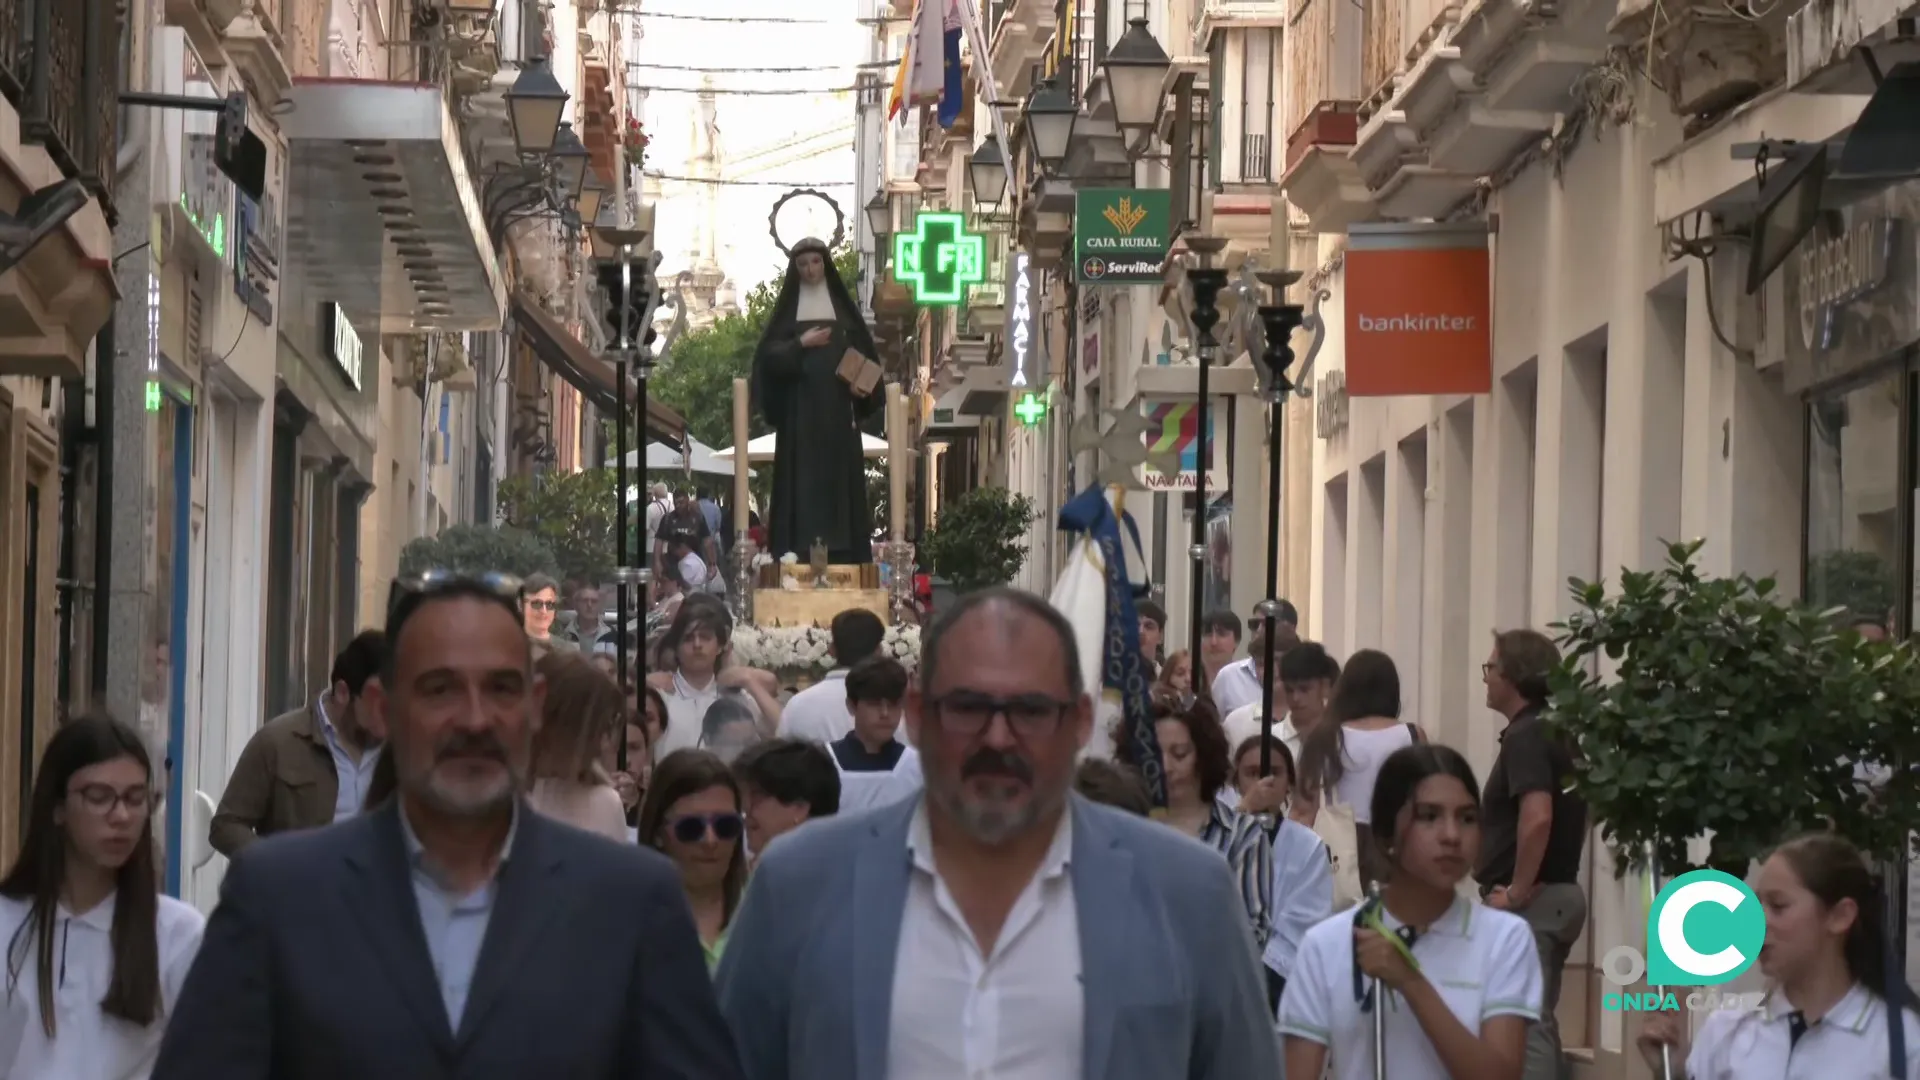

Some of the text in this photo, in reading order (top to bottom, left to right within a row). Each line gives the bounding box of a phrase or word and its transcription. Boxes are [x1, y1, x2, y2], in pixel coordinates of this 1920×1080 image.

[1086, 237, 1161, 248] CAJA RURAL
[1012, 253, 1031, 386] FARMACIA
[1145, 473, 1214, 487] NAUTALA
